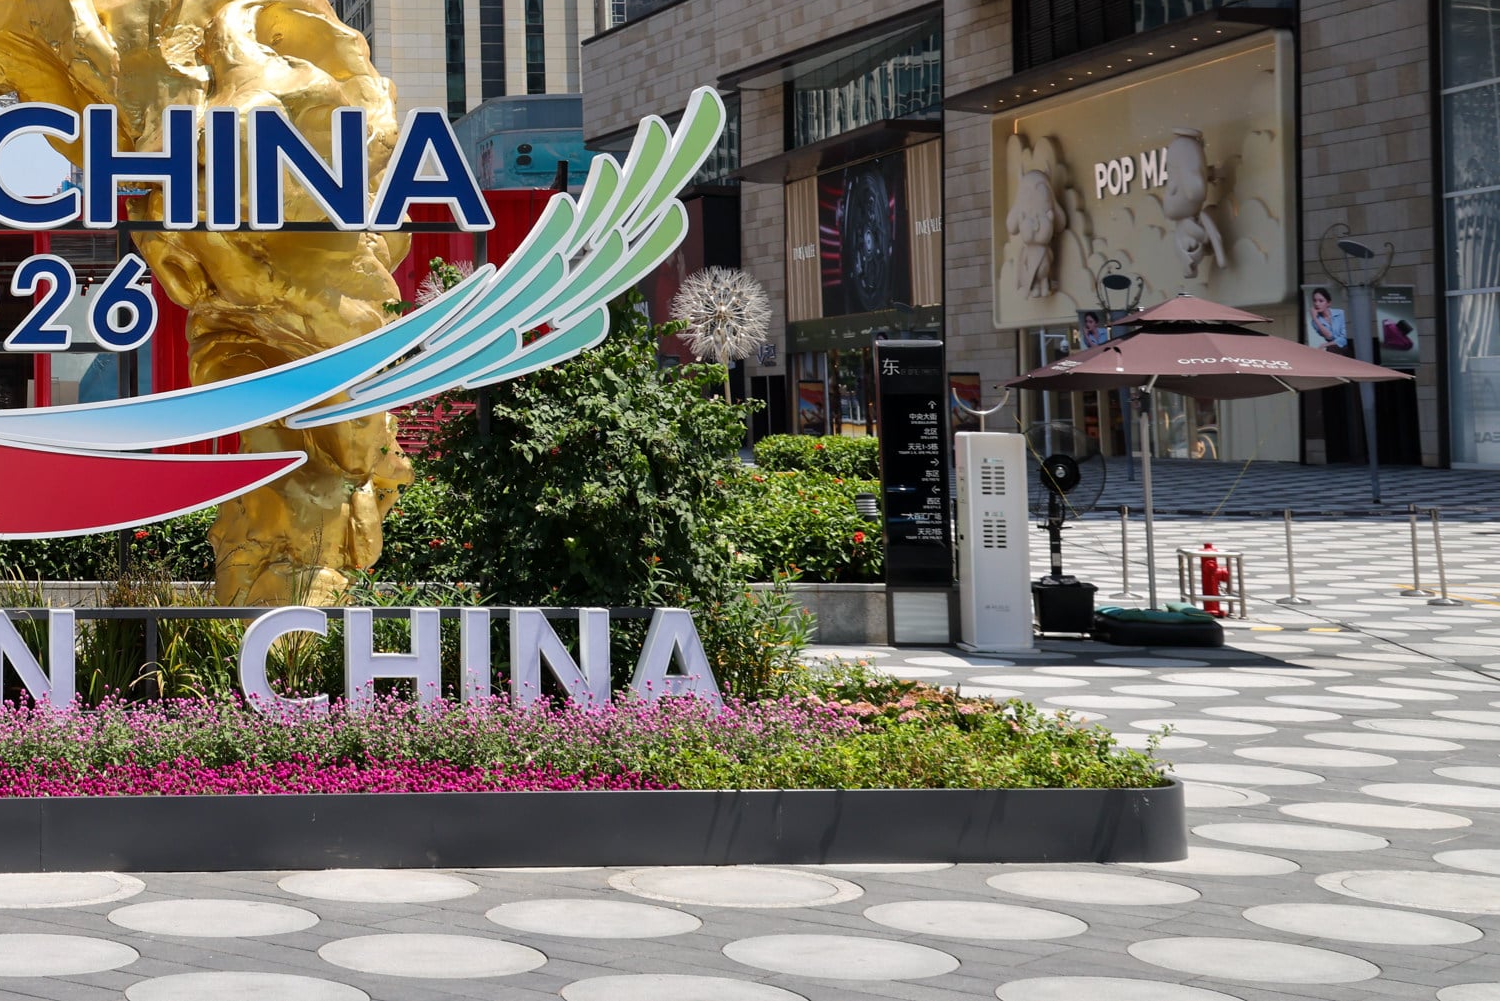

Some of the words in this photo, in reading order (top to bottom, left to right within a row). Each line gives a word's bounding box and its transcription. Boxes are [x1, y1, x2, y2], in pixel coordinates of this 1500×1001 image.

[1094, 156, 1134, 200] POP
[881, 358, 900, 376] 东
[238, 606, 723, 722] CHINA
